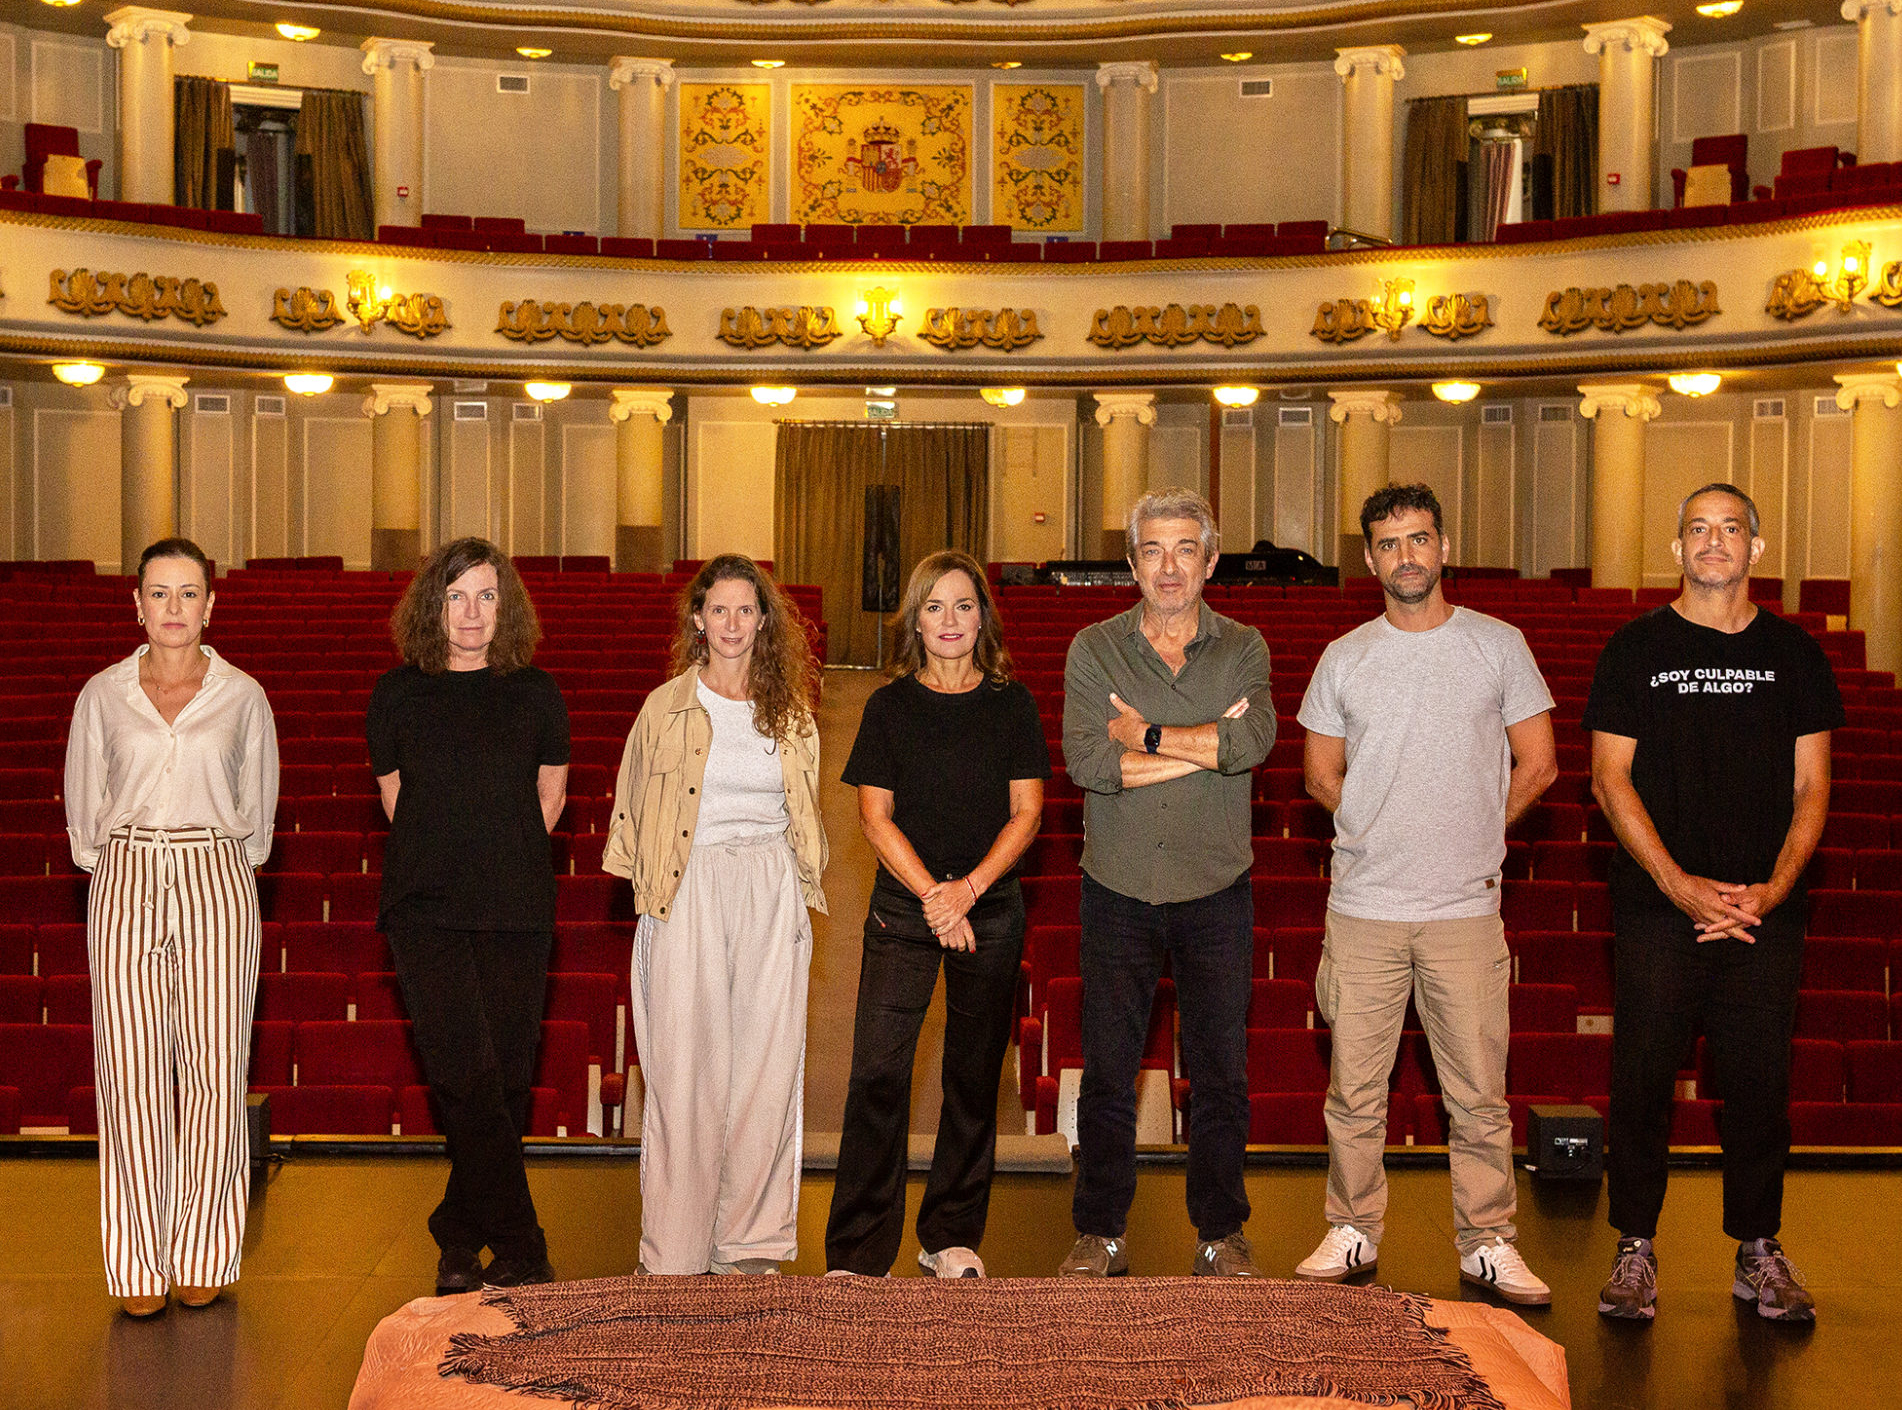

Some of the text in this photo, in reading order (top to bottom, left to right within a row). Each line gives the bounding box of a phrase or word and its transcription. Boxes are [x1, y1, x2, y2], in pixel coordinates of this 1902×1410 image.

[1650, 668, 1776, 687] ¿SOY CULPABLE
[1677, 681, 1754, 694] DE ALGO?
